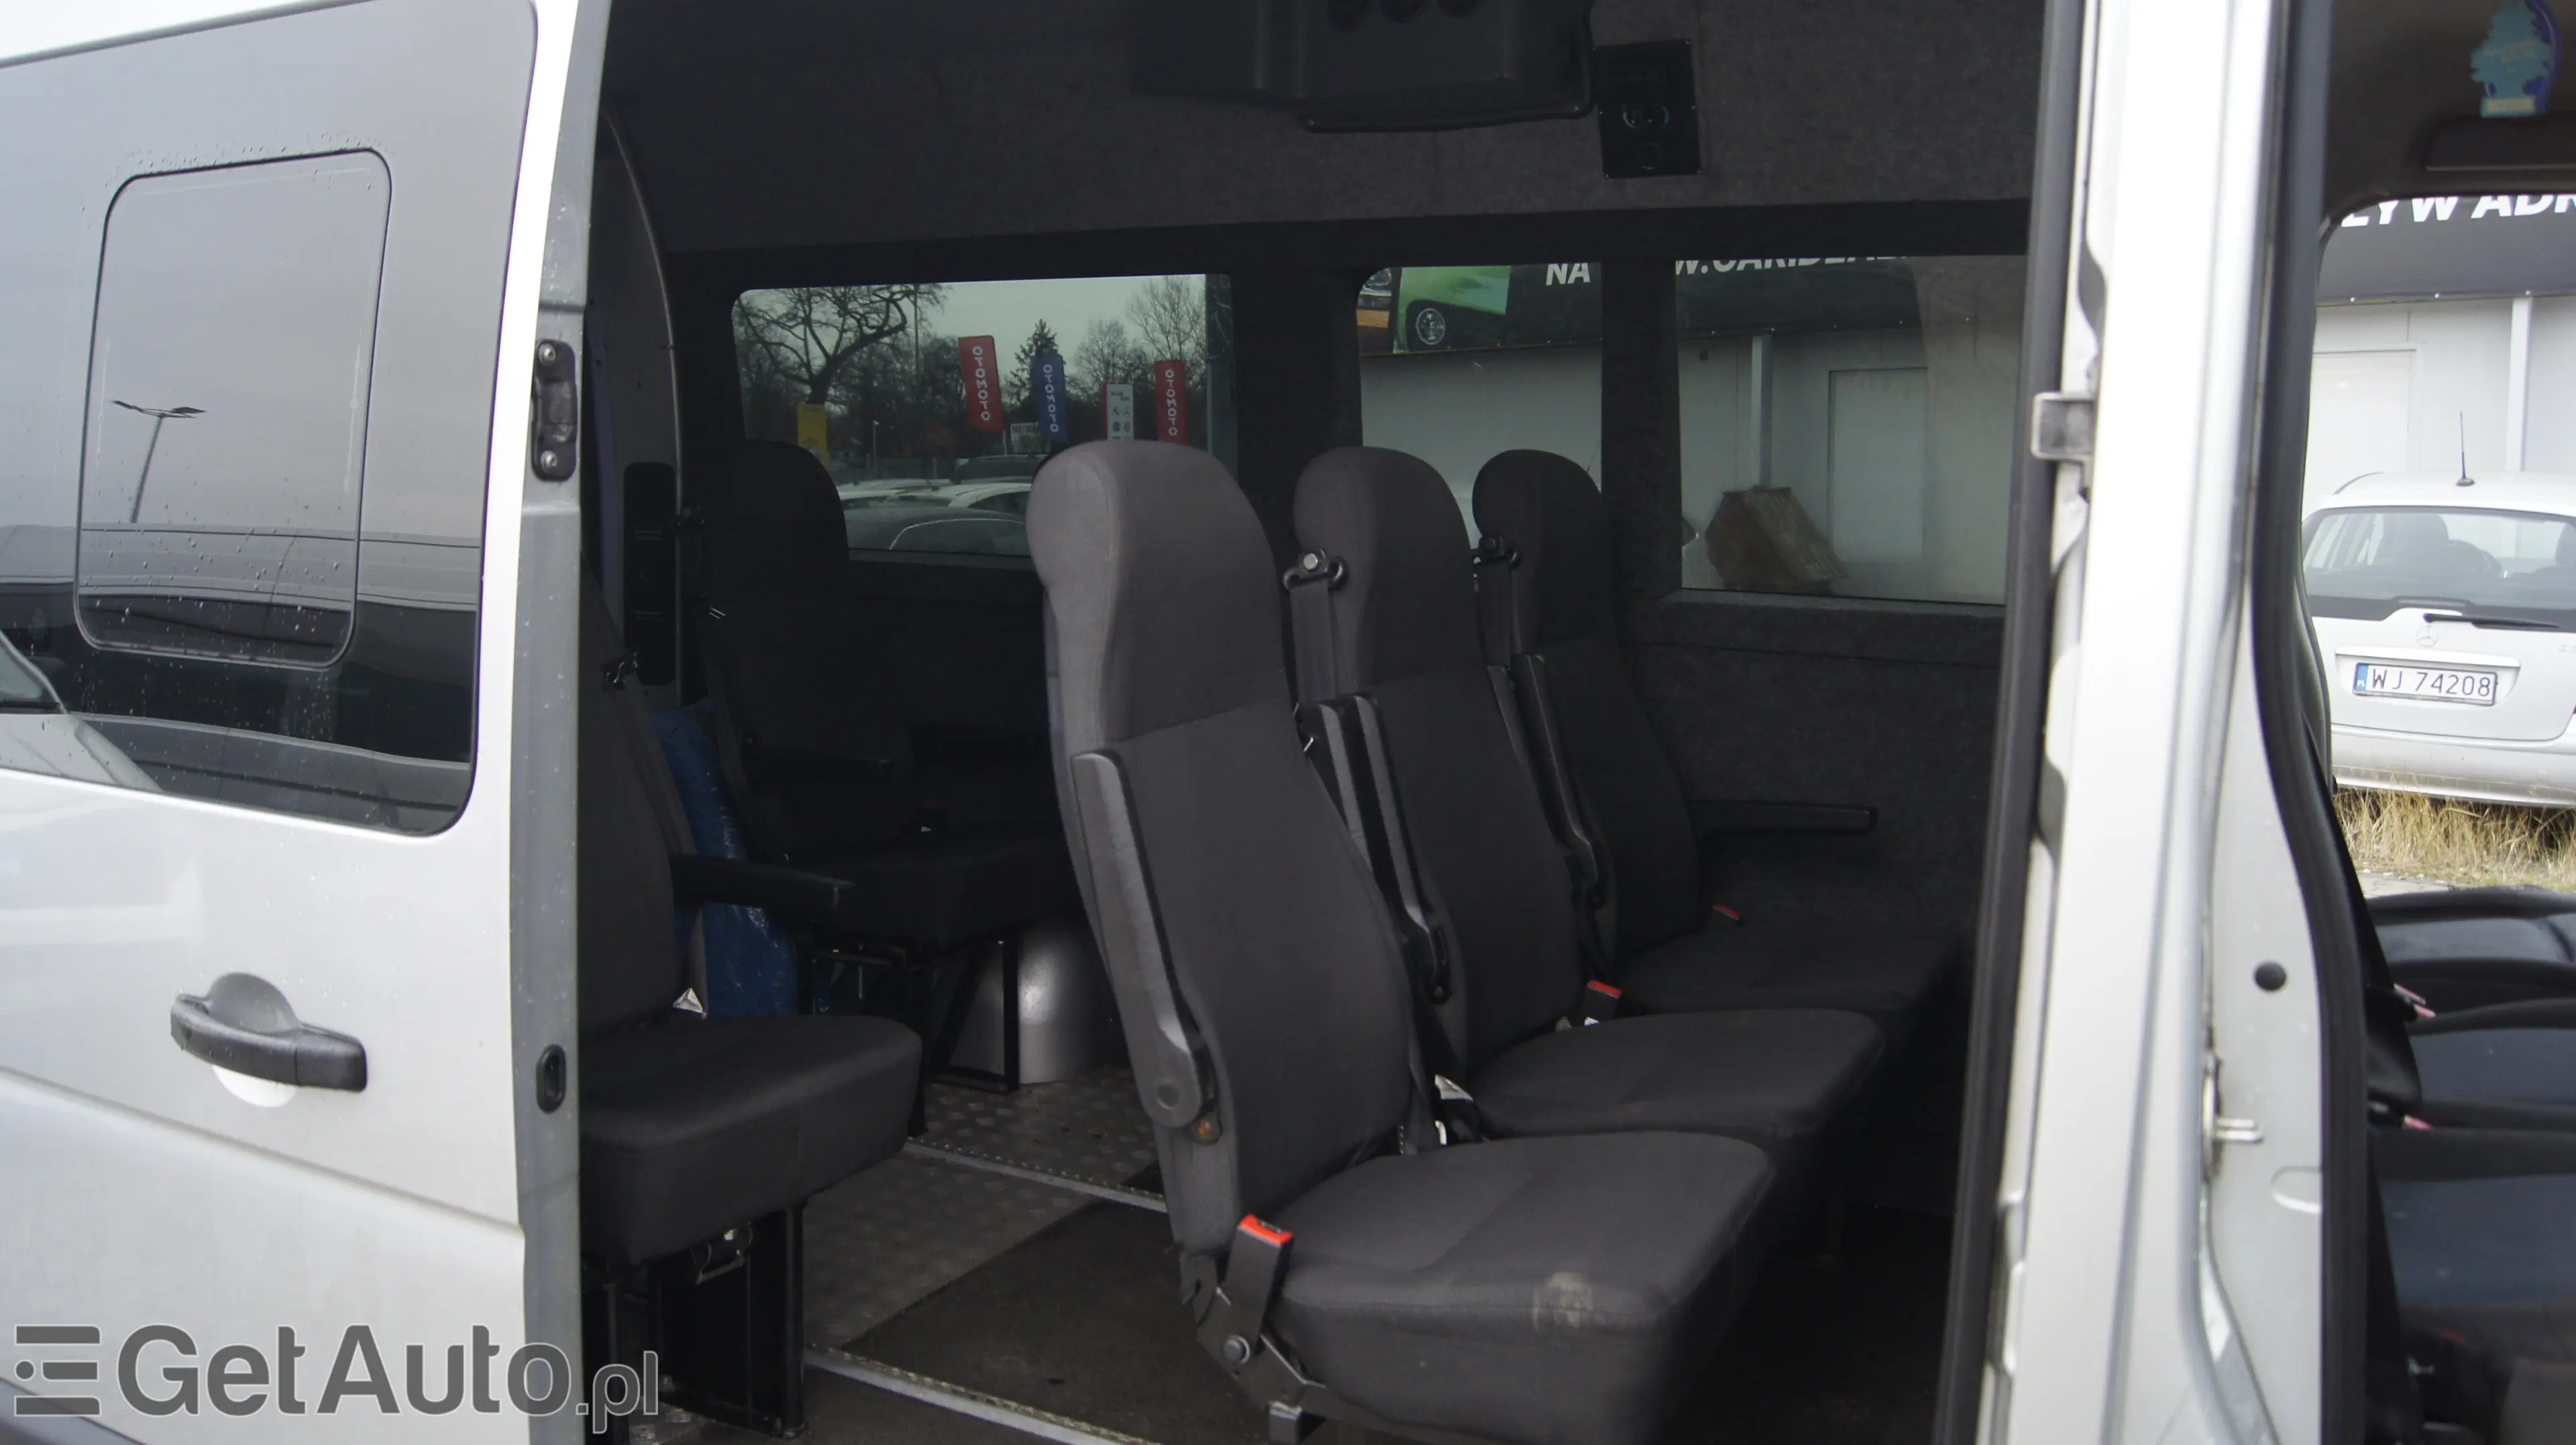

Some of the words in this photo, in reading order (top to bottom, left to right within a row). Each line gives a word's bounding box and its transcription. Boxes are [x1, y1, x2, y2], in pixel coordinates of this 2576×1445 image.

[1546, 262, 1591, 286] NA
[972, 345, 991, 421] OTOMOTO
[1042, 364, 1059, 433] OTOMOTO
[1165, 369, 1178, 436] OTOMOTO
[2357, 679, 2365, 688] PL
[2371, 668, 2403, 690] WJ
[2414, 671, 2491, 697] 74208
